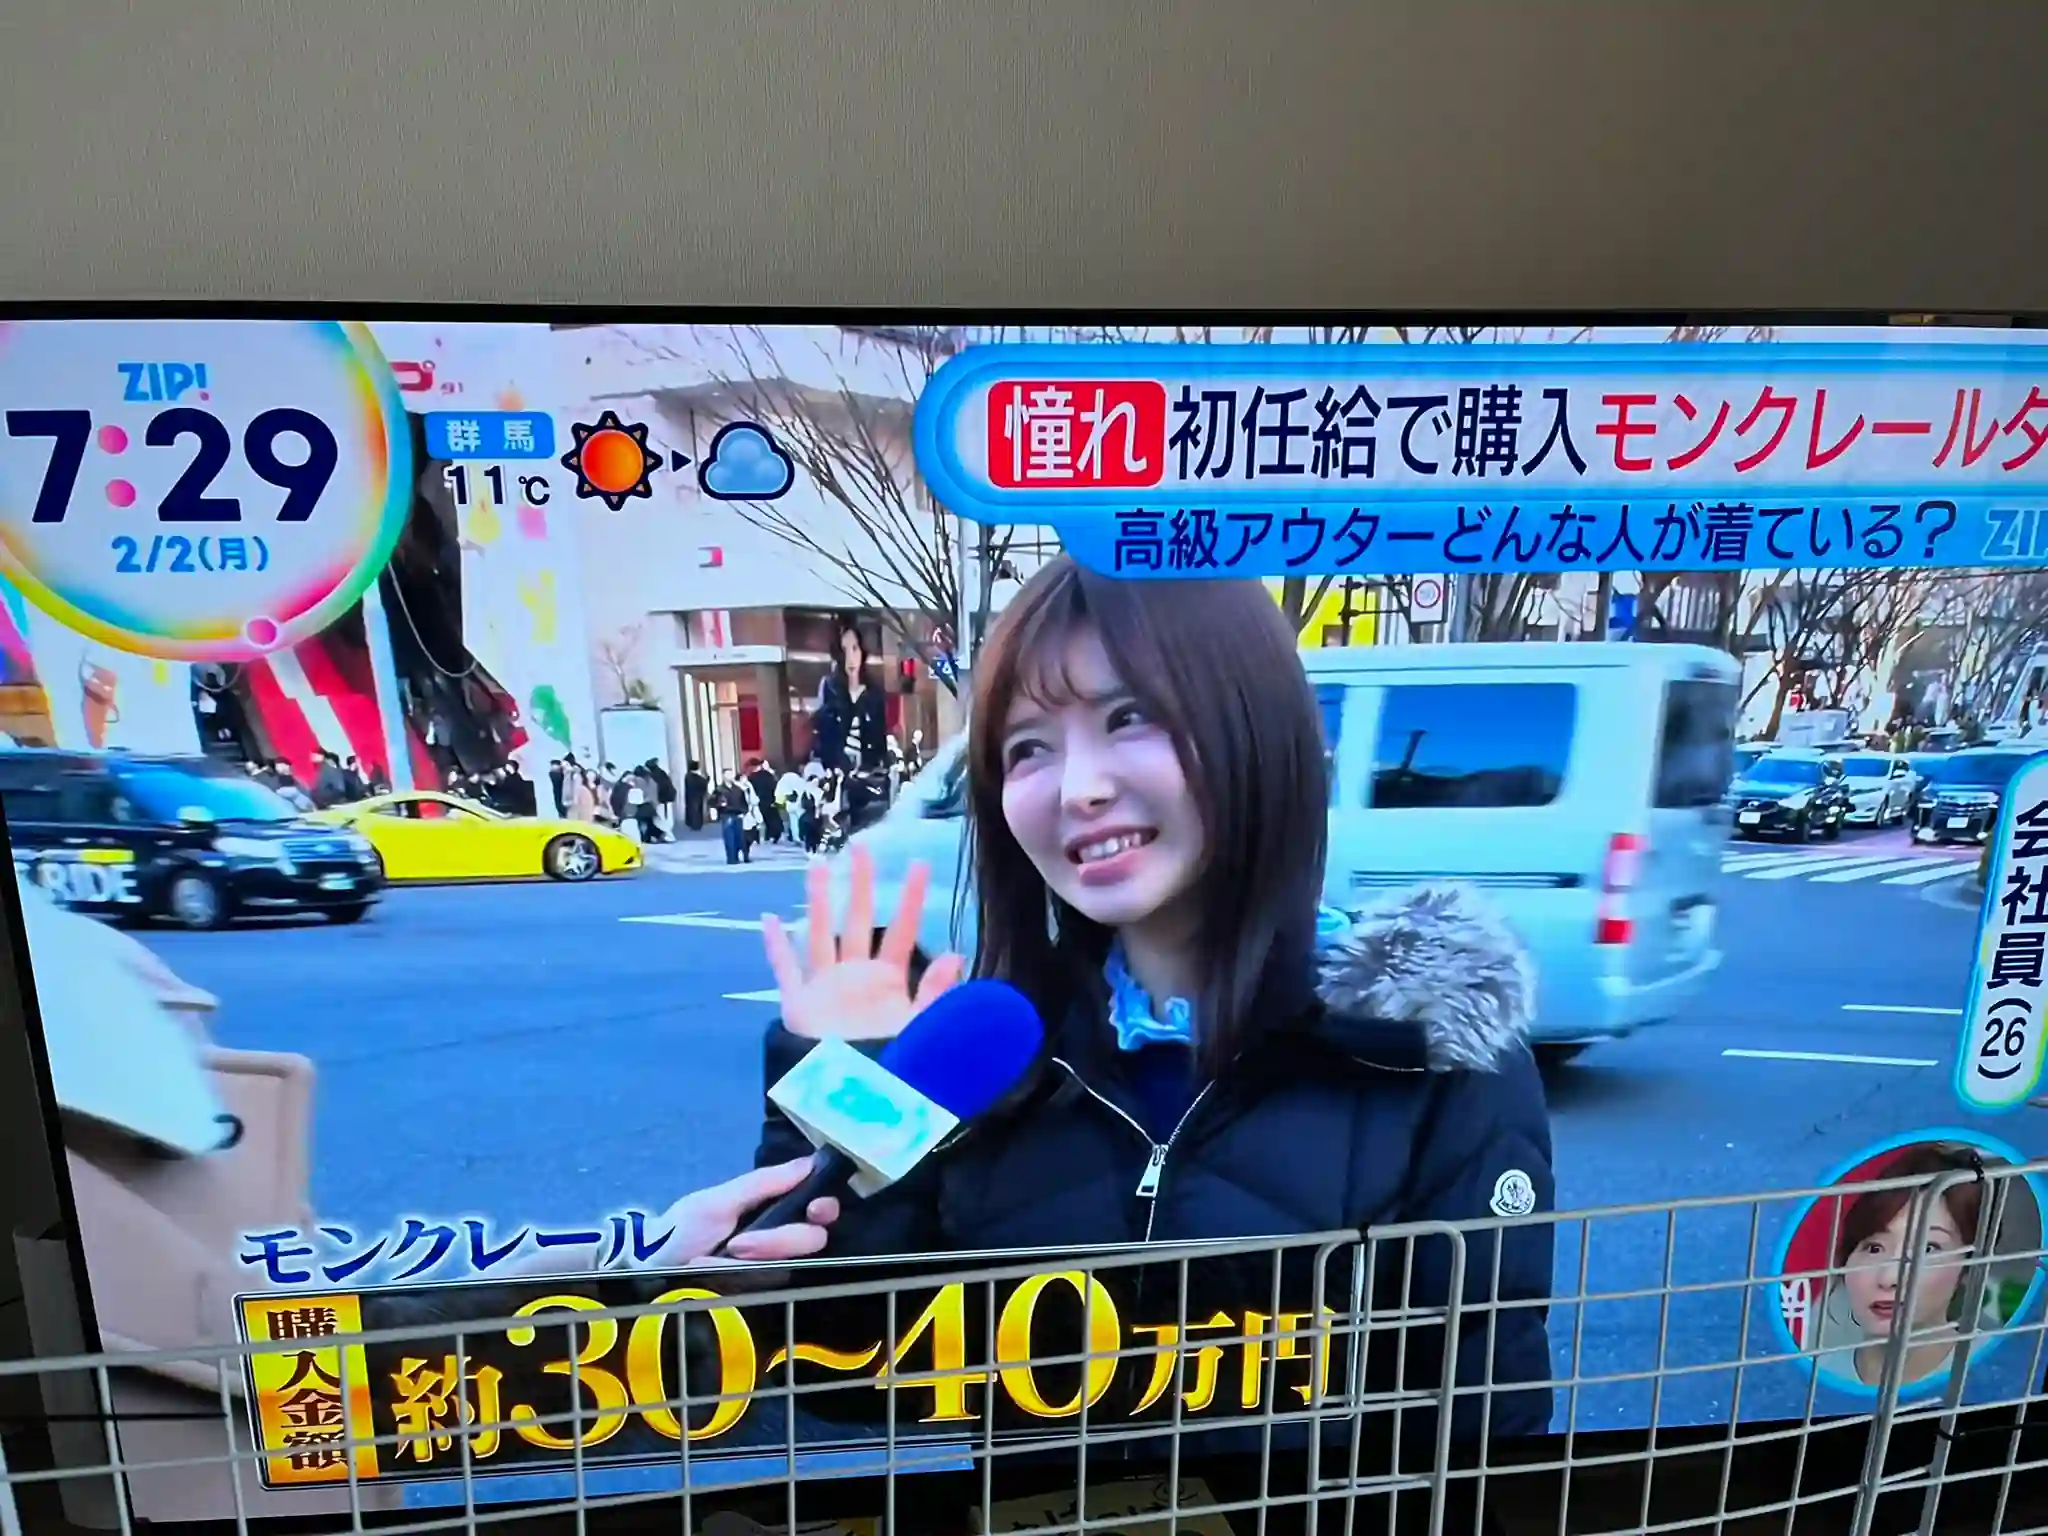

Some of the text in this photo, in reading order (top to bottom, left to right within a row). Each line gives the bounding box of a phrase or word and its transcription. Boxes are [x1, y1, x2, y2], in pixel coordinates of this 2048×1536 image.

[117, 362, 210, 402] ZIP!
[5, 407, 339, 523] 7:29
[445, 419, 536, 453] 群馬
[1003, 384, 1148, 483] 憧れ
[111, 535, 269, 573] 2/2(月)
[1114, 500, 1957, 573] 高級アウターどんな人が着ている？
[1980, 509, 2048, 560] ZI
[240, 1210, 676, 1284] モンクレール
[271, 1307, 352, 1471] 購入金額
